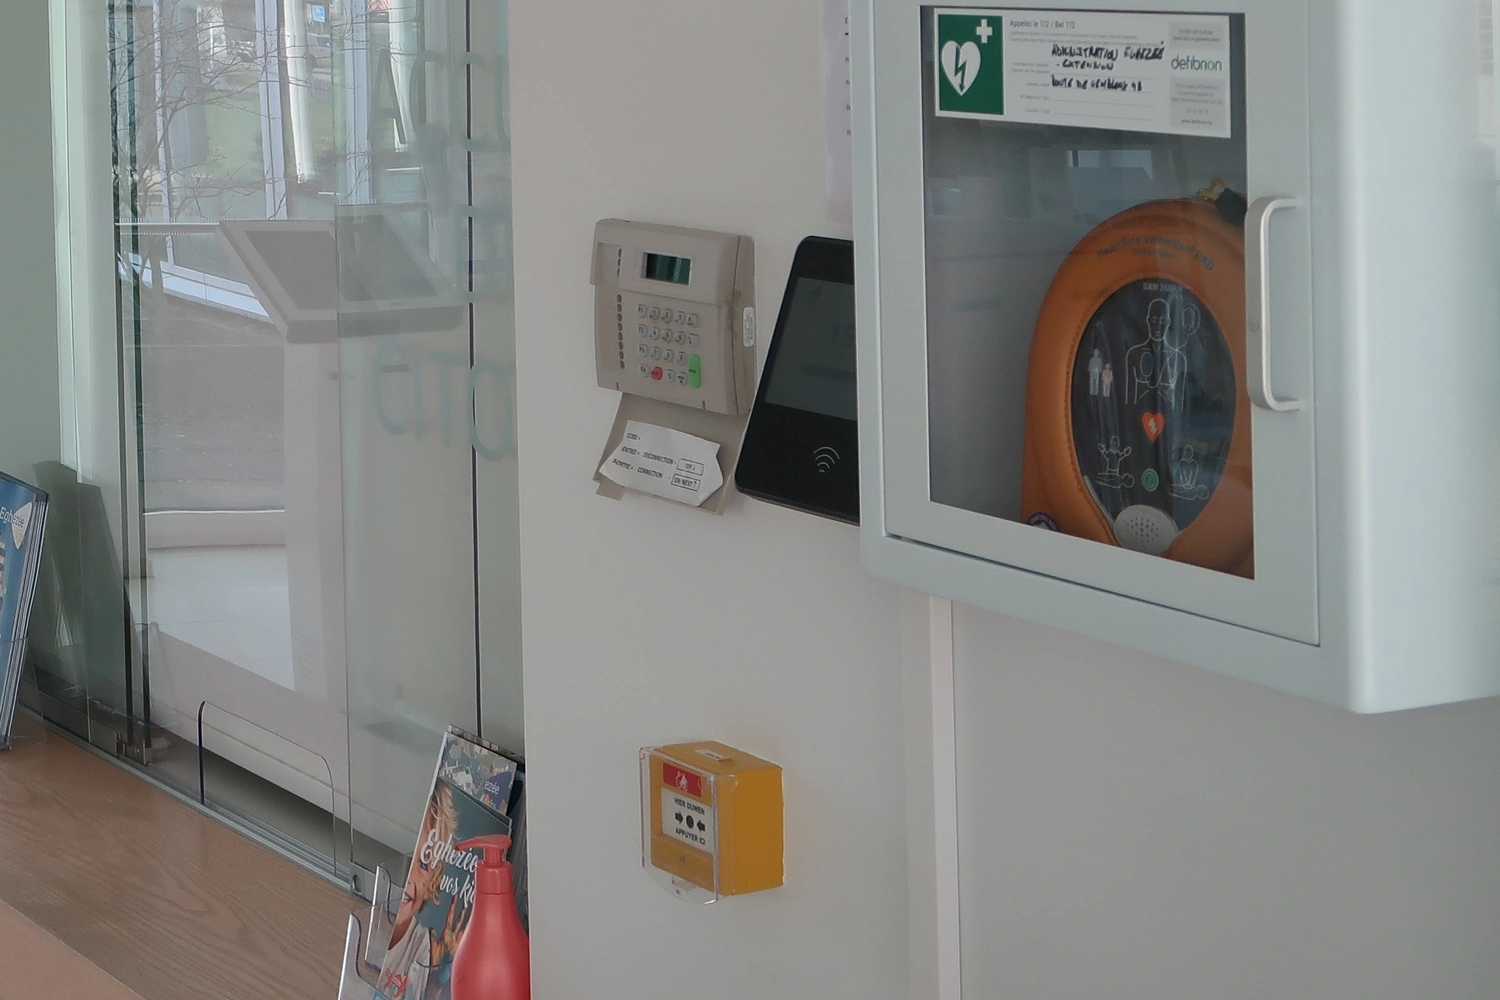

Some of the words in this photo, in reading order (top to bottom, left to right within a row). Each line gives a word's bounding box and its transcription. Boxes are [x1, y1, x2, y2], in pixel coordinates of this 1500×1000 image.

[1010, 19, 1032, 29] Appelez
[1040, 20, 1050, 28] 112
[1055, 20, 1065, 28] Bel
[1066, 21, 1076, 29] 112
[1171, 54, 1222, 72] defibrion
[1194, 250, 1214, 271] PAD
[0, 506, 25, 529] Eghezée
[674, 797, 686, 808] HIER
[686, 801, 706, 816] DUWEN
[675, 827, 698, 842] APPUYER
[420, 828, 479, 873] Eghezée
[440, 874, 459, 896] vos
